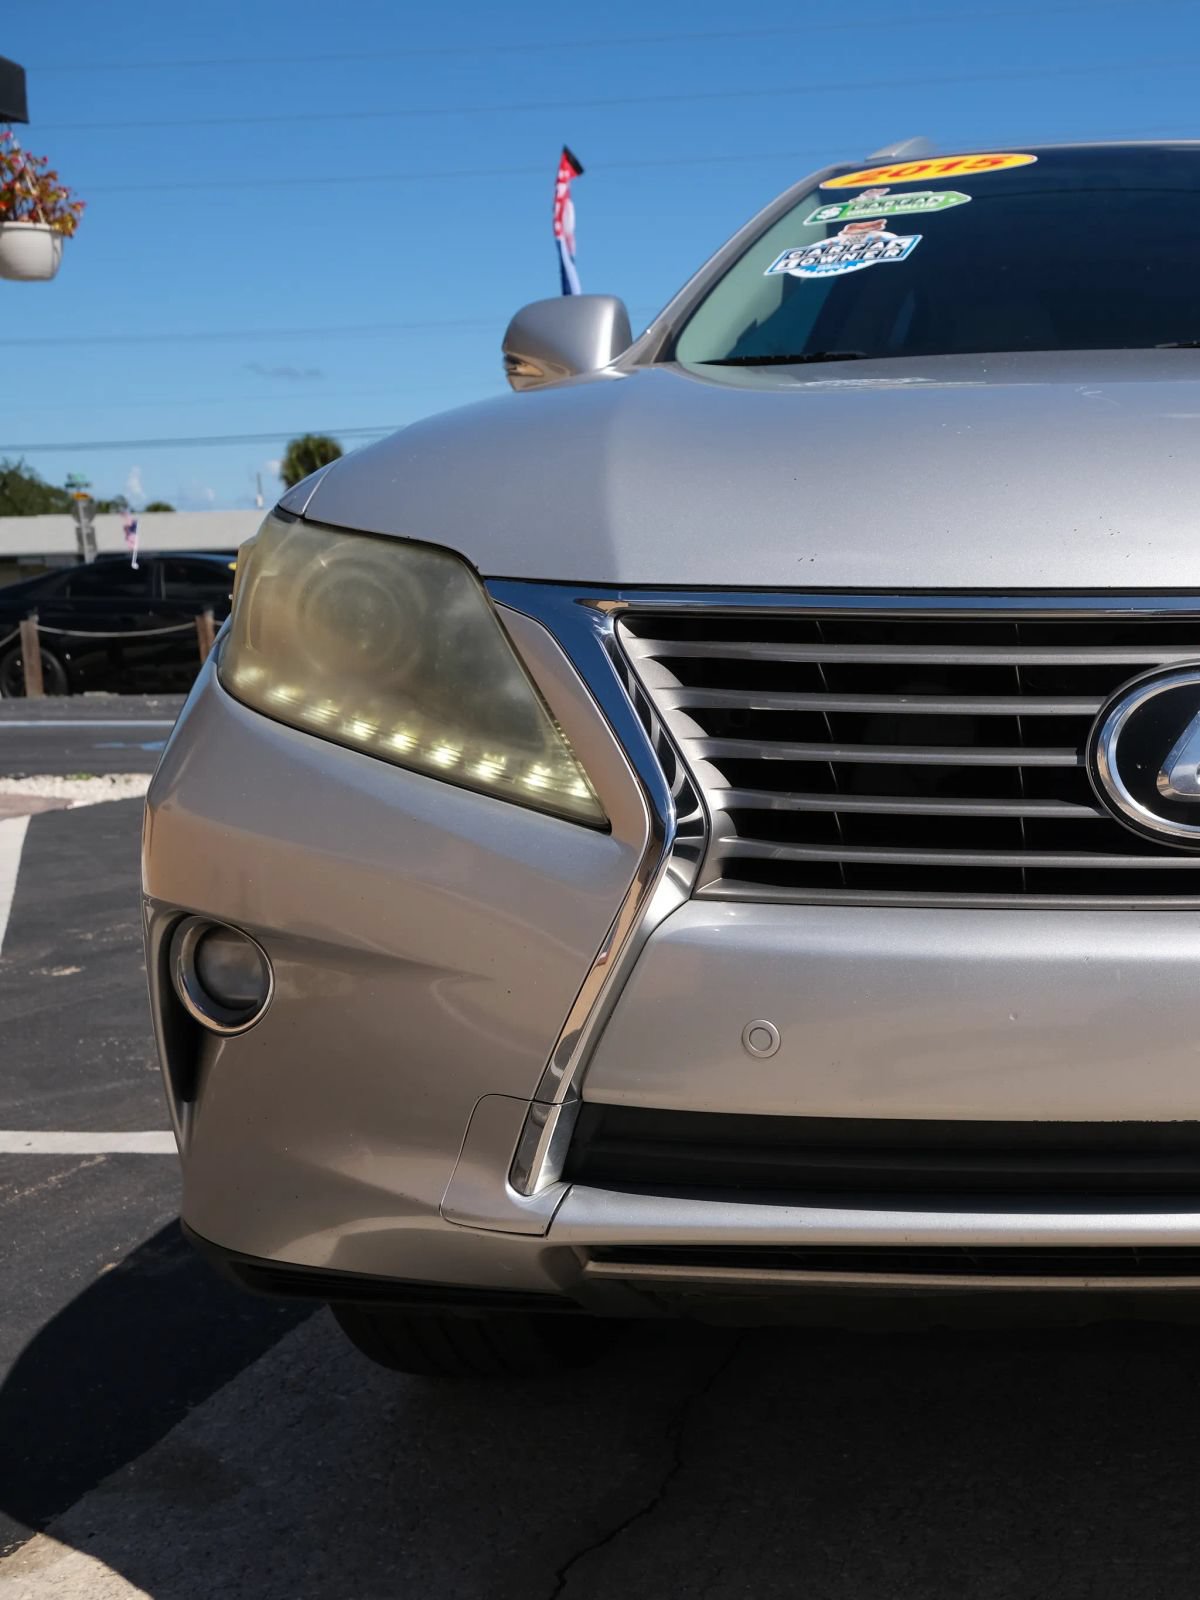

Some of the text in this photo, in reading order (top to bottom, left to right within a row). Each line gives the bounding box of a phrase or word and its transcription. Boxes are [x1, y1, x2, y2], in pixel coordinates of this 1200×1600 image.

[844, 155, 1014, 185] 2015
[786, 238, 909, 259] CARFAX
[800, 248, 902, 266] OWNER
